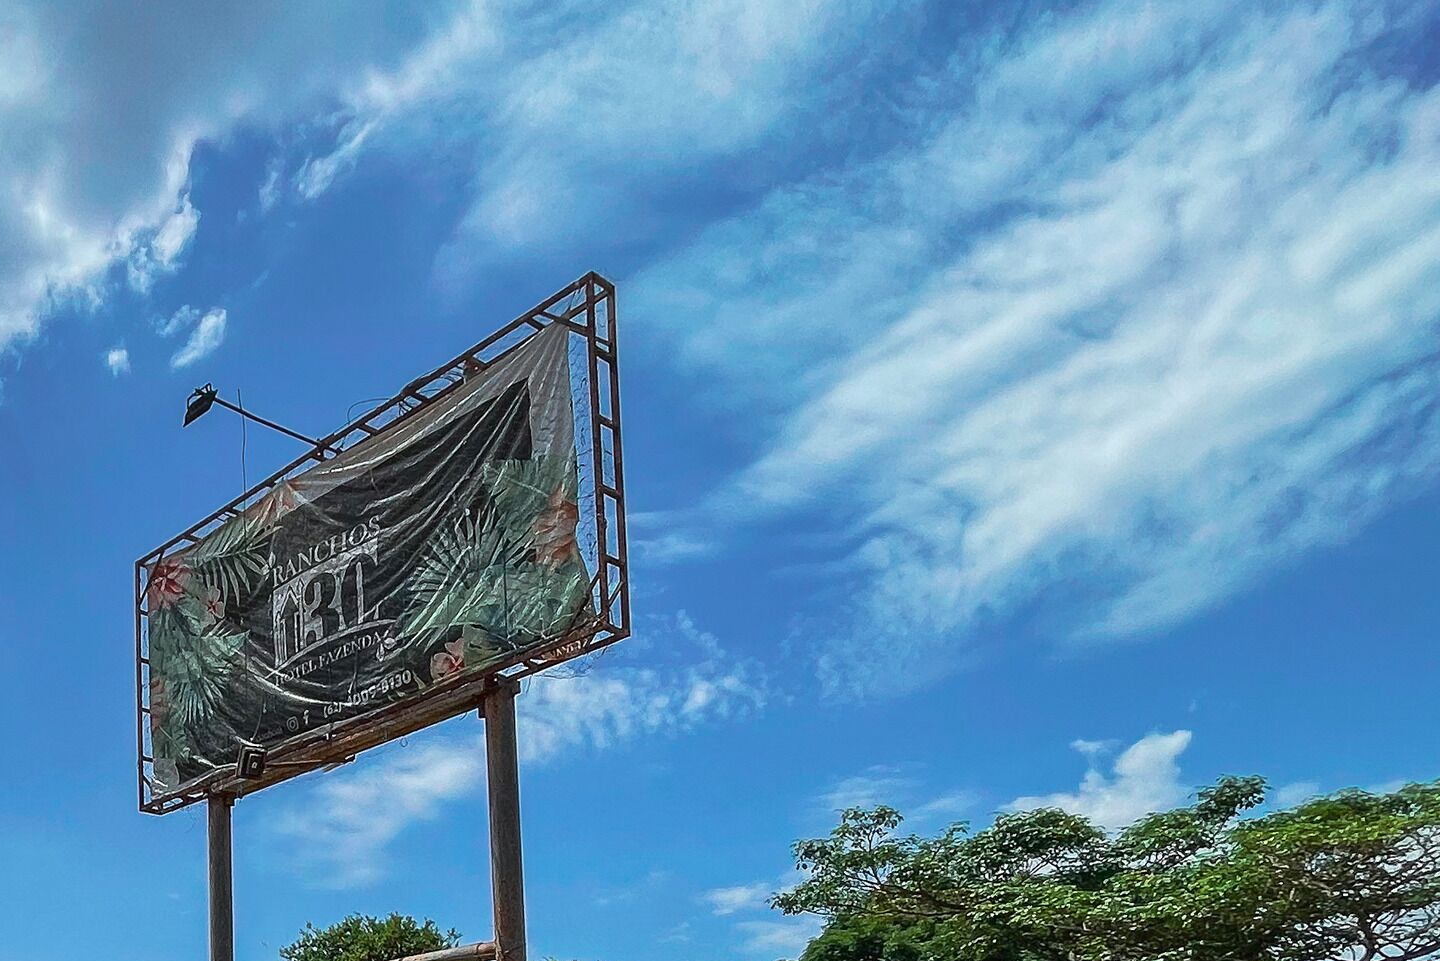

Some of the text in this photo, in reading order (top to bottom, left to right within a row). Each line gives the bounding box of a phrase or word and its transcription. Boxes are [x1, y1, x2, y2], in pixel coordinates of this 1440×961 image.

[273, 515, 381, 587] RANCHOS
[275, 631, 384, 687] HOTEL FAZENDA
